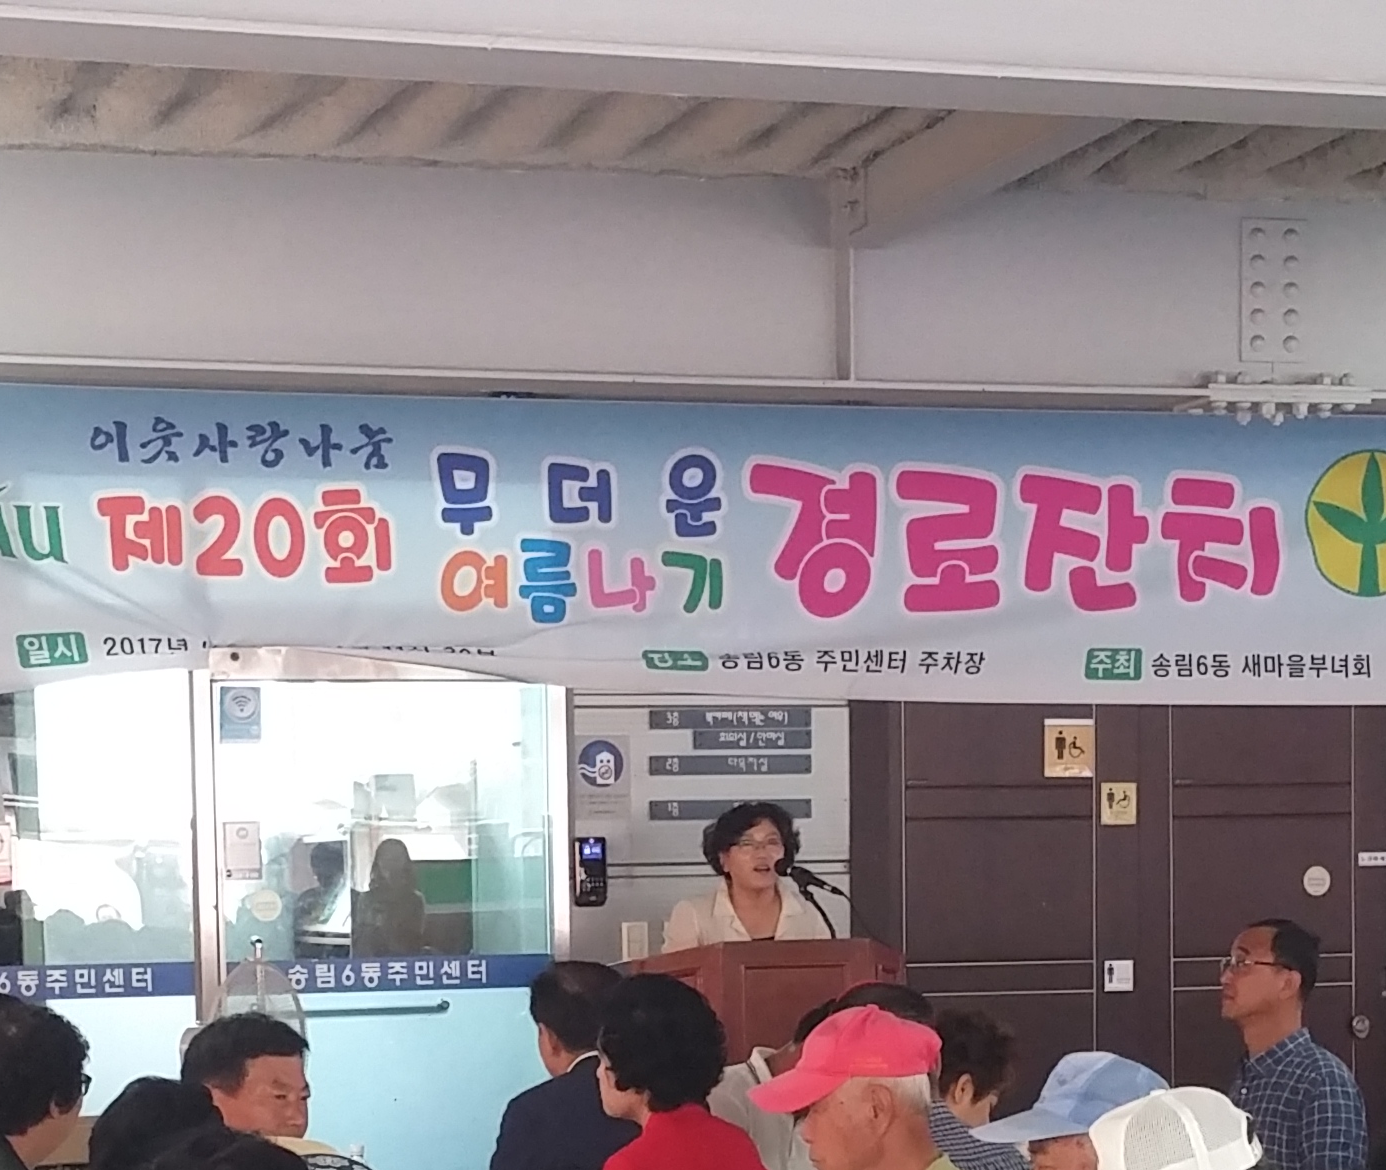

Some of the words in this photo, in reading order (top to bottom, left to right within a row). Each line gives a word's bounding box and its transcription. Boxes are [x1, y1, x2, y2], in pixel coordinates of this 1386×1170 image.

[89, 416, 393, 470] 이웃사랑나눔
[97, 488, 392, 584] 제20회
[749, 463, 1280, 618] 경로잔치
[440, 538, 723, 623] 여름나기
[23, 634, 81, 665] 일시
[816, 650, 907, 674] 주민센터
[918, 651, 986, 674] 주차장
[1089, 650, 1135, 677] 주최
[1151, 653, 1231, 677] 송림6동
[1241, 653, 1372, 678] 새마을부녀회
[287, 959, 488, 990] 송림6동주민센터
